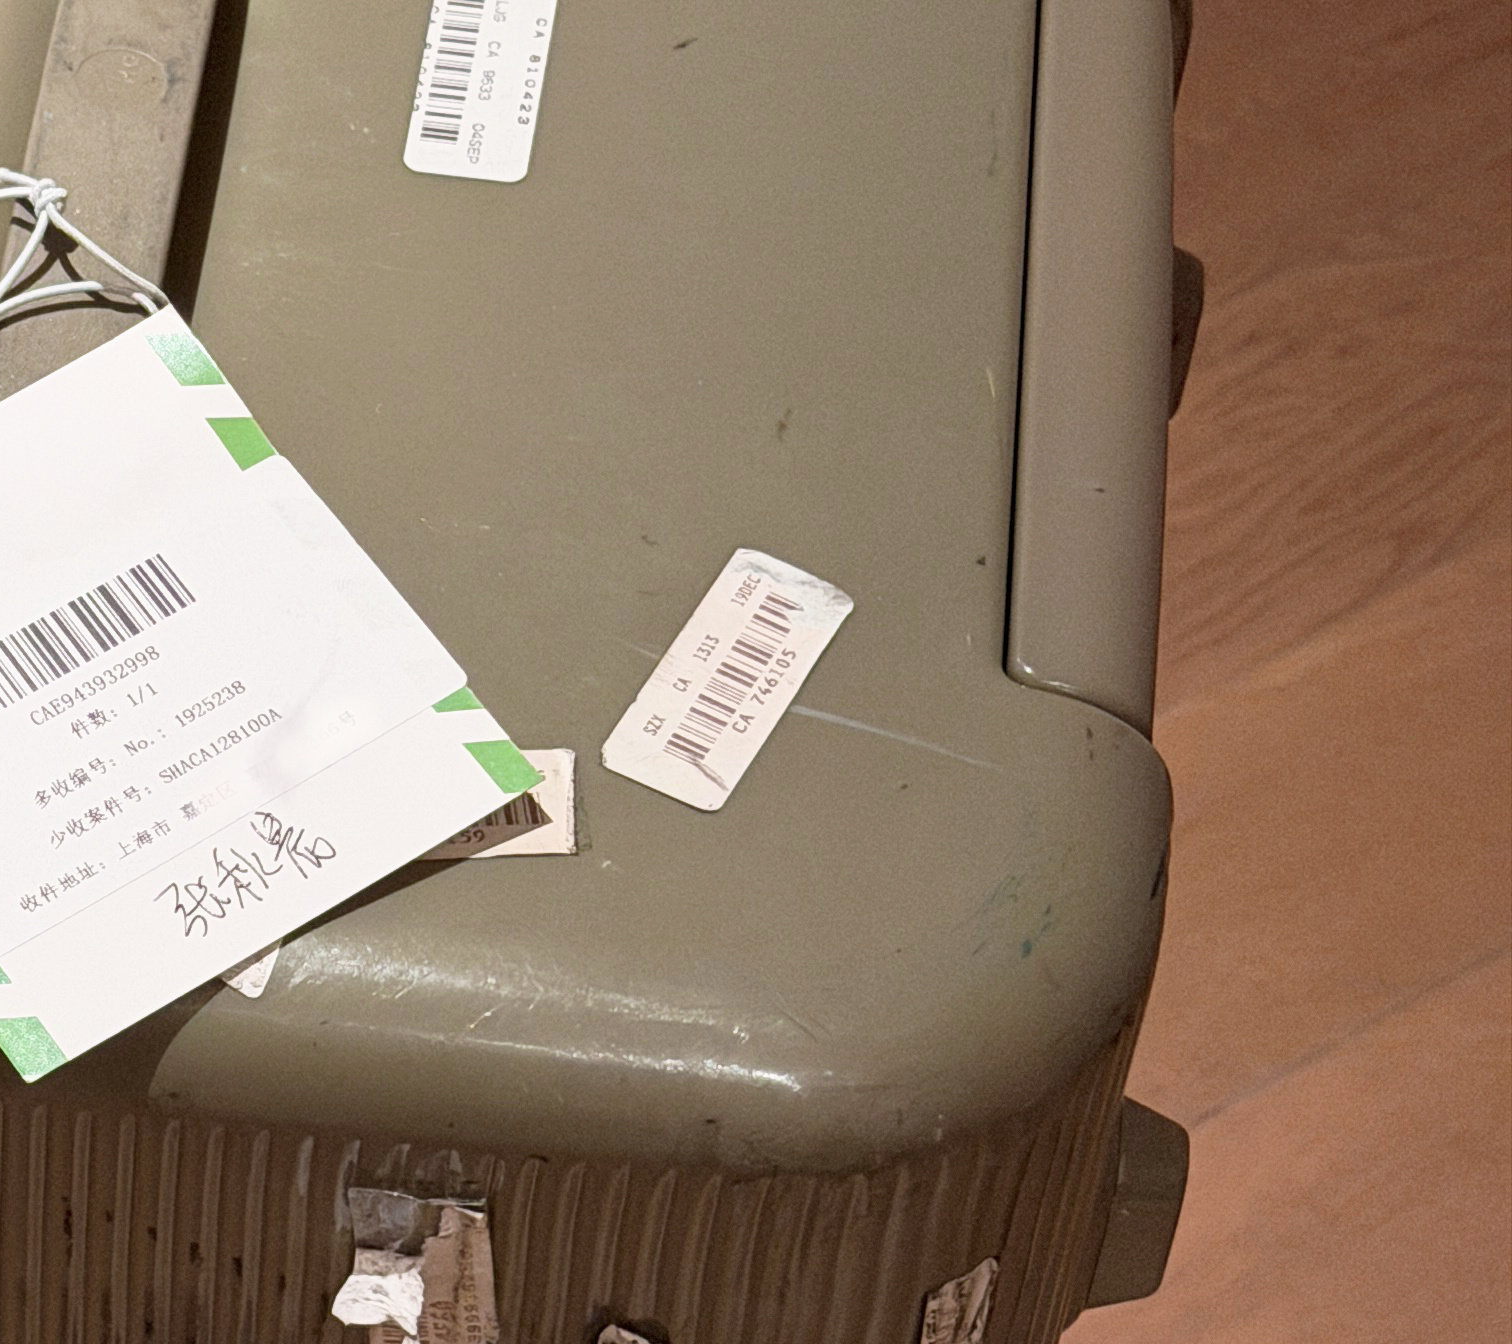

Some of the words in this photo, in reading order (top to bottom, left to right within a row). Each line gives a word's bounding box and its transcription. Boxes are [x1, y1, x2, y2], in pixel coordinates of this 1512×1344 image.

[487, 40, 501, 58] CA
[533, 17, 547, 39] CA
[517, 54, 541, 126] 810423
[28, 643, 161, 728] CAE943932998
[643, 712, 666, 737] SZX
[672, 675, 692, 693] CA
[730, 572, 761, 608] 19DEC
[731, 711, 755, 735] CA
[750, 646, 798, 707] 746105
